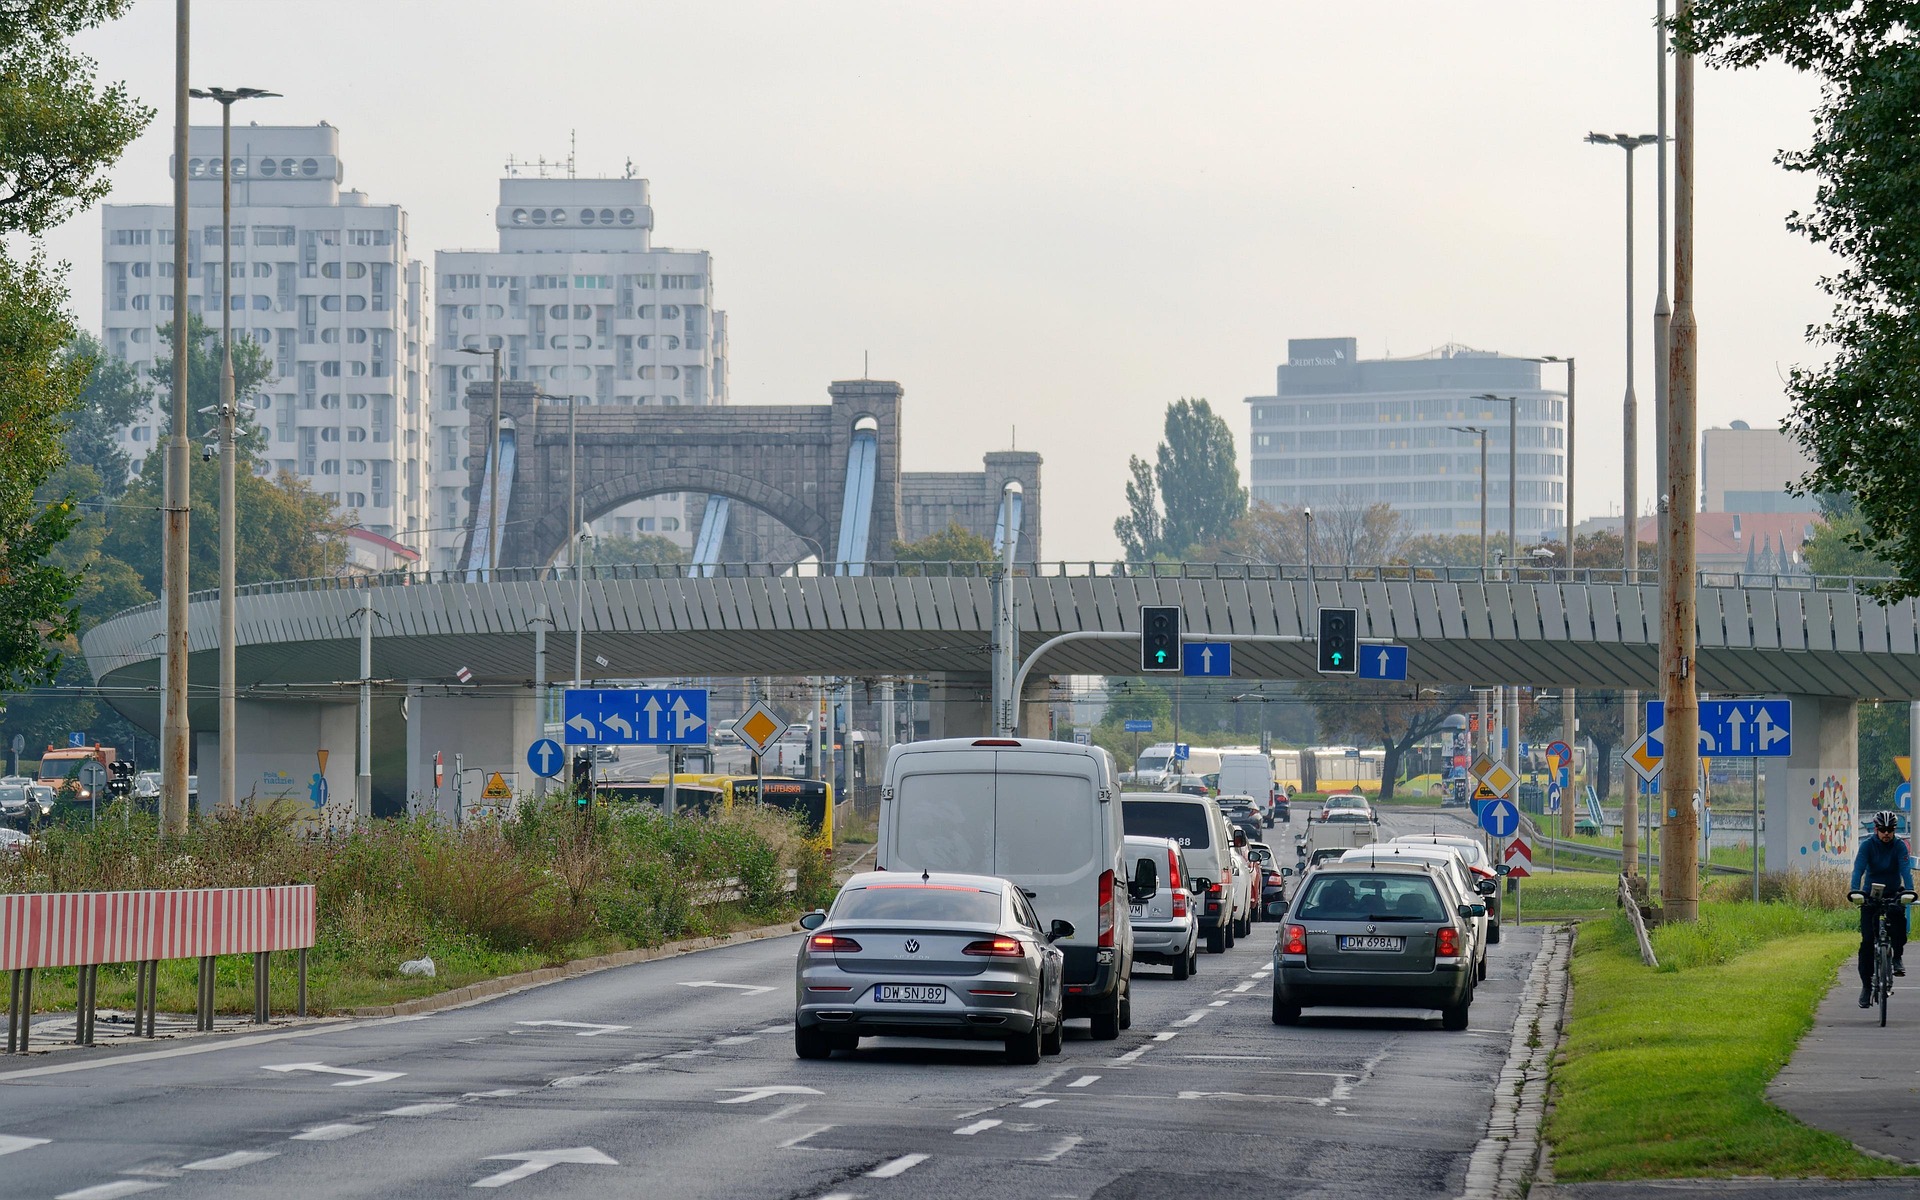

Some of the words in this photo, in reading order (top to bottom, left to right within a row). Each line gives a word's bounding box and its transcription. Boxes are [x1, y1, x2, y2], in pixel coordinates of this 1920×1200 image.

[1348, 938, 1363, 948] DW
[1367, 938, 1399, 949] 698AJ
[883, 986, 900, 999] DW
[904, 987, 942, 1000] 5NJ89
